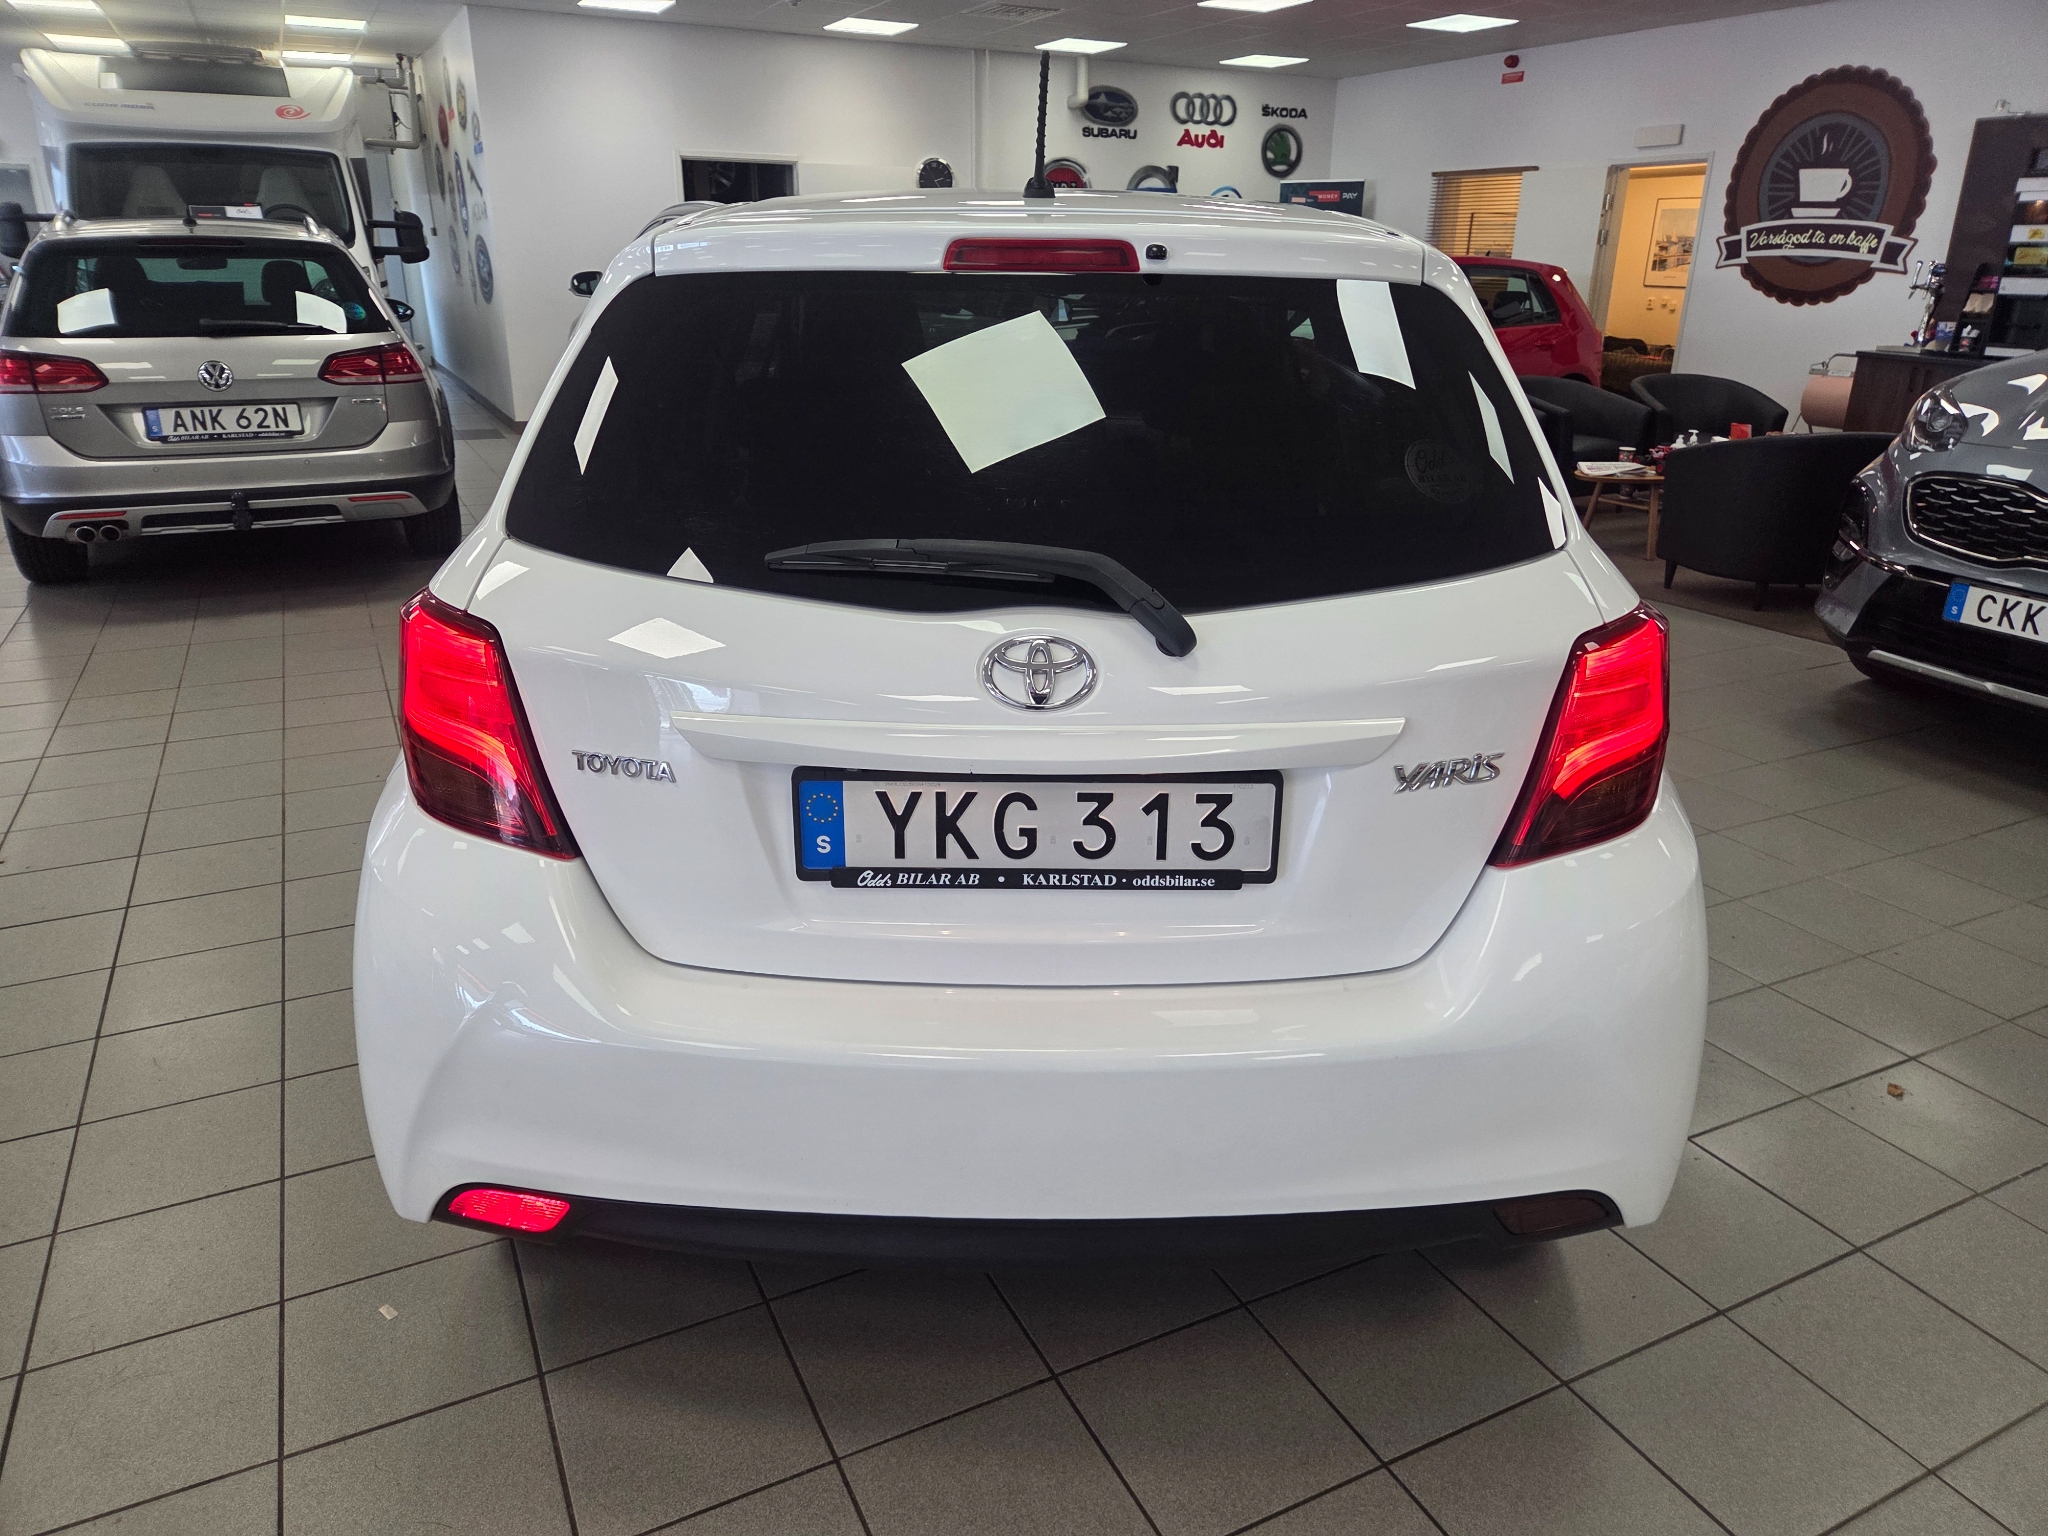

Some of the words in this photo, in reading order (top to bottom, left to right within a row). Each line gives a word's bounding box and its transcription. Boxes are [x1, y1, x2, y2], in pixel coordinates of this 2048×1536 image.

[1261, 103, 1308, 119] ŠKODA
[1082, 126, 1138, 139] SUBARU
[1176, 128, 1225, 149] Audi
[1341, 191, 1358, 200] PAY
[1828, 233, 1846, 245] en
[173, 408, 227, 432] ANK
[235, 407, 290, 430] 62N
[1950, 605, 1959, 615] S
[1976, 594, 2048, 636] CKK
[571, 750, 677, 783] TOYOTA
[874, 790, 1039, 860] YKG
[1072, 791, 1236, 862] 313
[816, 834, 831, 854] S
[896, 872, 952, 885] BILAR
[955, 873, 980, 885] AB
[1022, 873, 1118, 887] KARLSTAD
[1132, 875, 1216, 888] oddsbilar.se
